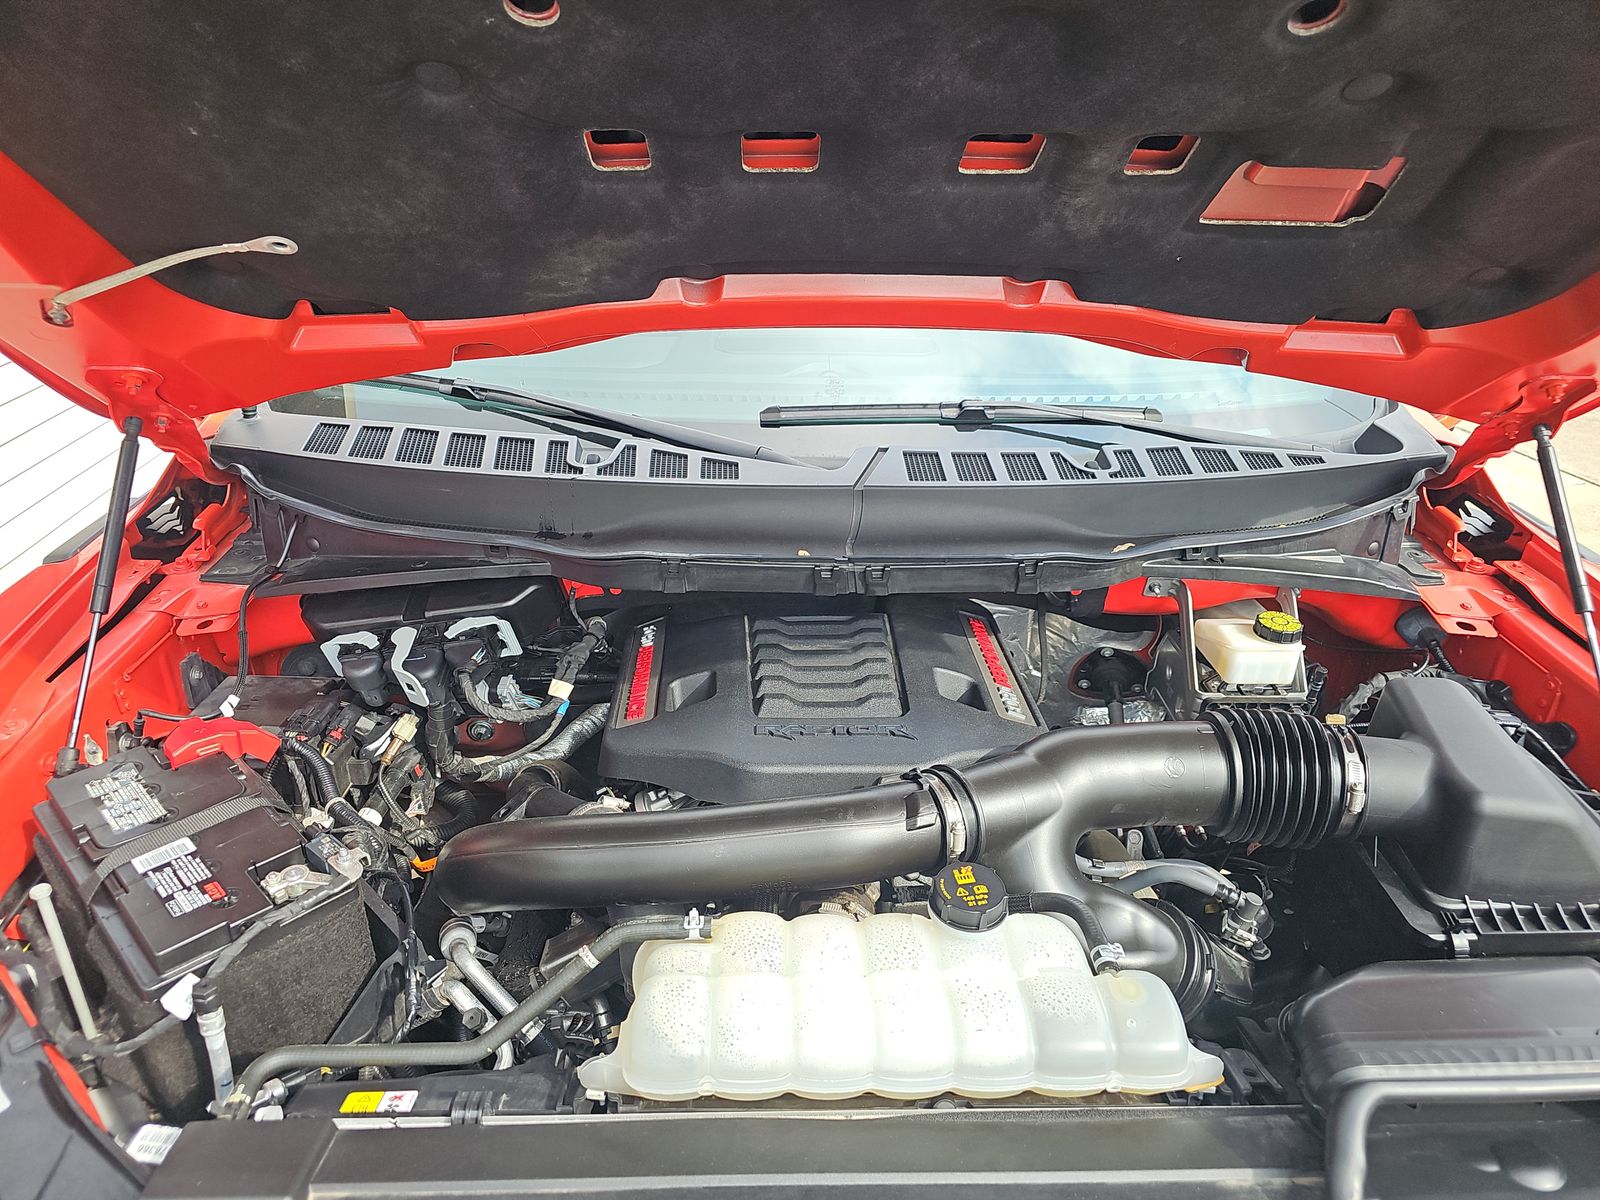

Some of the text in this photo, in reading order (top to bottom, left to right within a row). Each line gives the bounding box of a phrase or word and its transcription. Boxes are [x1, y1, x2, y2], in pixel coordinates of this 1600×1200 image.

[968, 617, 1026, 720] FORD PERFORMANCE
[754, 724, 919, 741] RAPTOR
